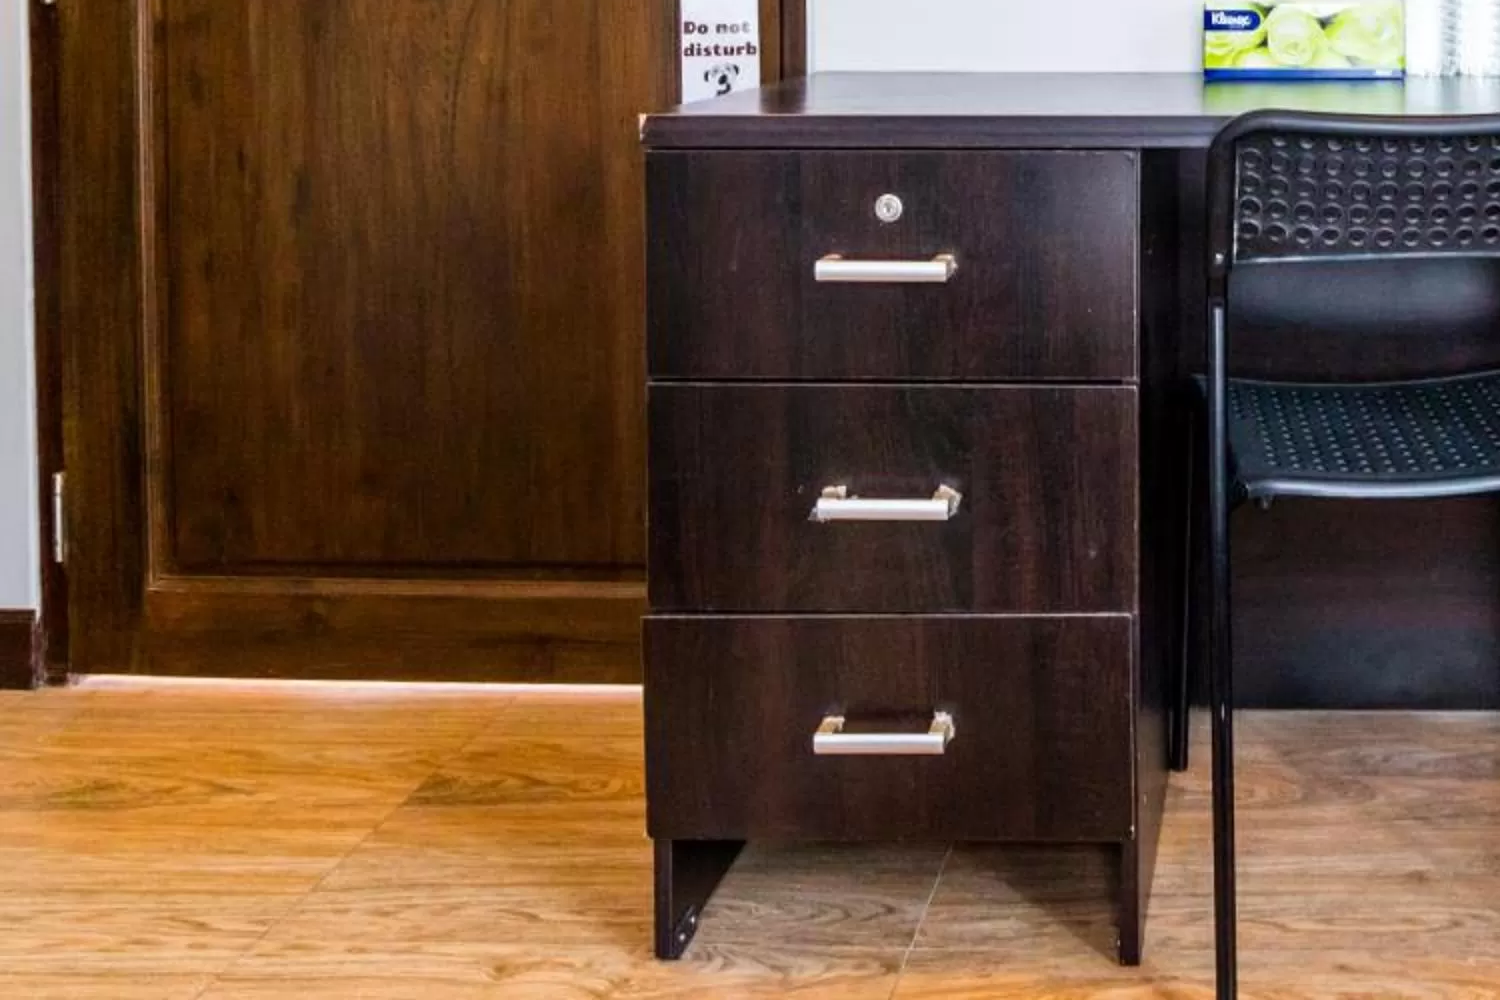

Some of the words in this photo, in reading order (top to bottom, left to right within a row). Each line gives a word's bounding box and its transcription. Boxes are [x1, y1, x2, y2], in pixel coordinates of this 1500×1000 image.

[684, 21, 708, 34] Do
[715, 21, 749, 34] not
[684, 41, 757, 57] disturb
